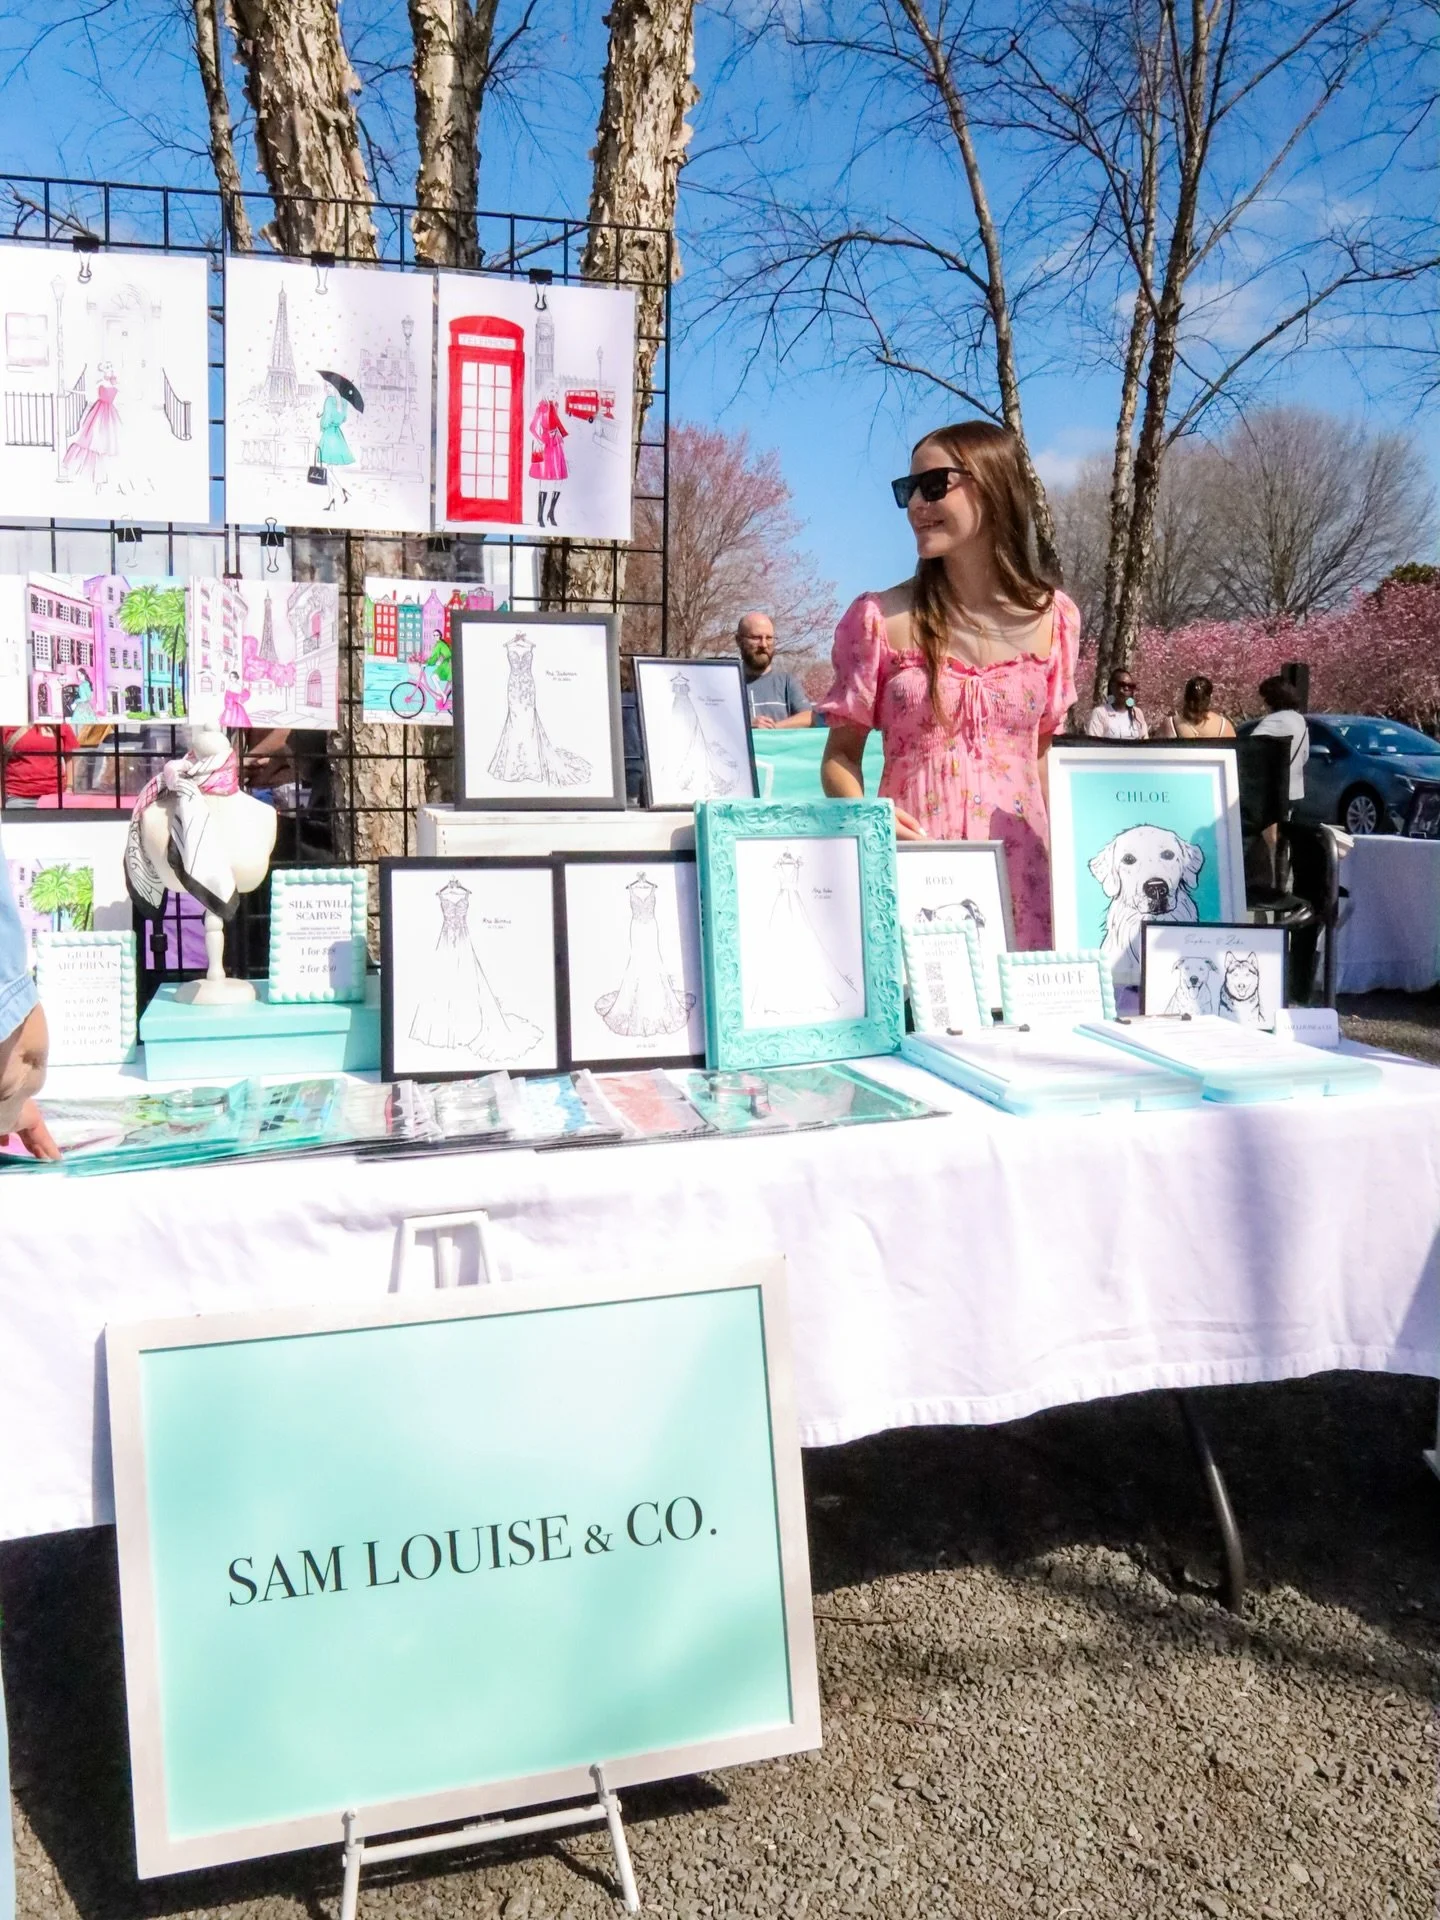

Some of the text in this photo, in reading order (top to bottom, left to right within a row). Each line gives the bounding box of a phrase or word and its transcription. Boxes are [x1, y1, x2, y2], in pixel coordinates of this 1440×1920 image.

[1115, 791, 1171, 803] CHLOE
[925, 875, 953, 885] RORY
[288, 899, 350, 909] SILK TWILL
[296, 911, 342, 921] SCARVES
[307, 947, 320, 956] for
[79, 961, 118, 970] PRINTS
[307, 964, 320, 973] for
[1027, 969, 1086, 986] $10 OFF
[228, 1495, 718, 1607] SAM LOUISE & CO.
